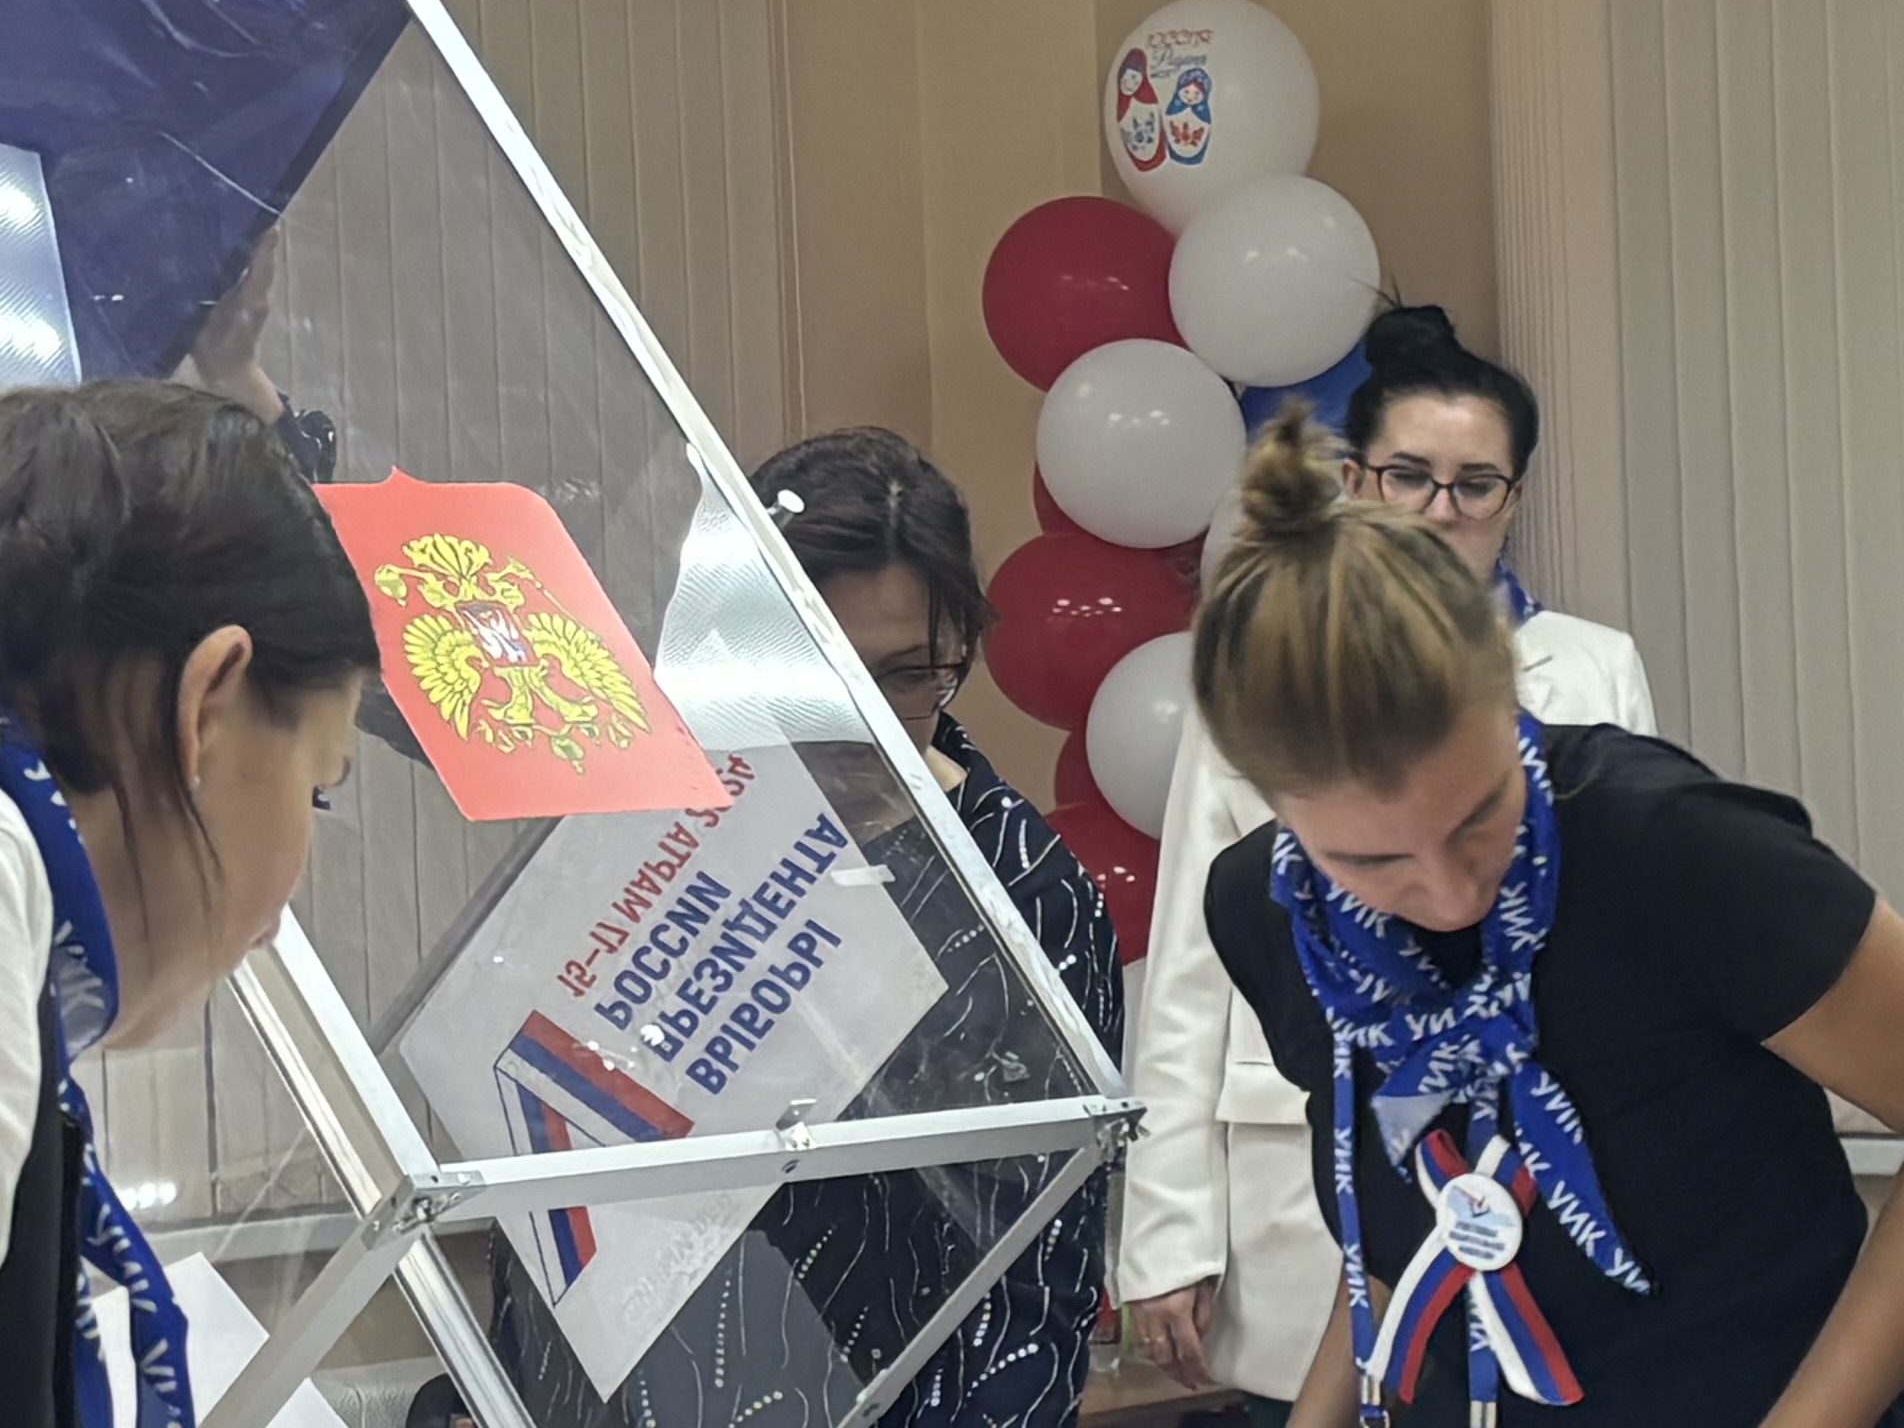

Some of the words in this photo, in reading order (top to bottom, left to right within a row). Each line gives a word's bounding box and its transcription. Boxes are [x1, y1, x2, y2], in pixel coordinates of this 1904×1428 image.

[1334, 1126, 1354, 1195] УИК
[1547, 1180, 1606, 1257] УИК
[1343, 1242, 1369, 1309] УИК
[1605, 1247, 1651, 1295] УИ
